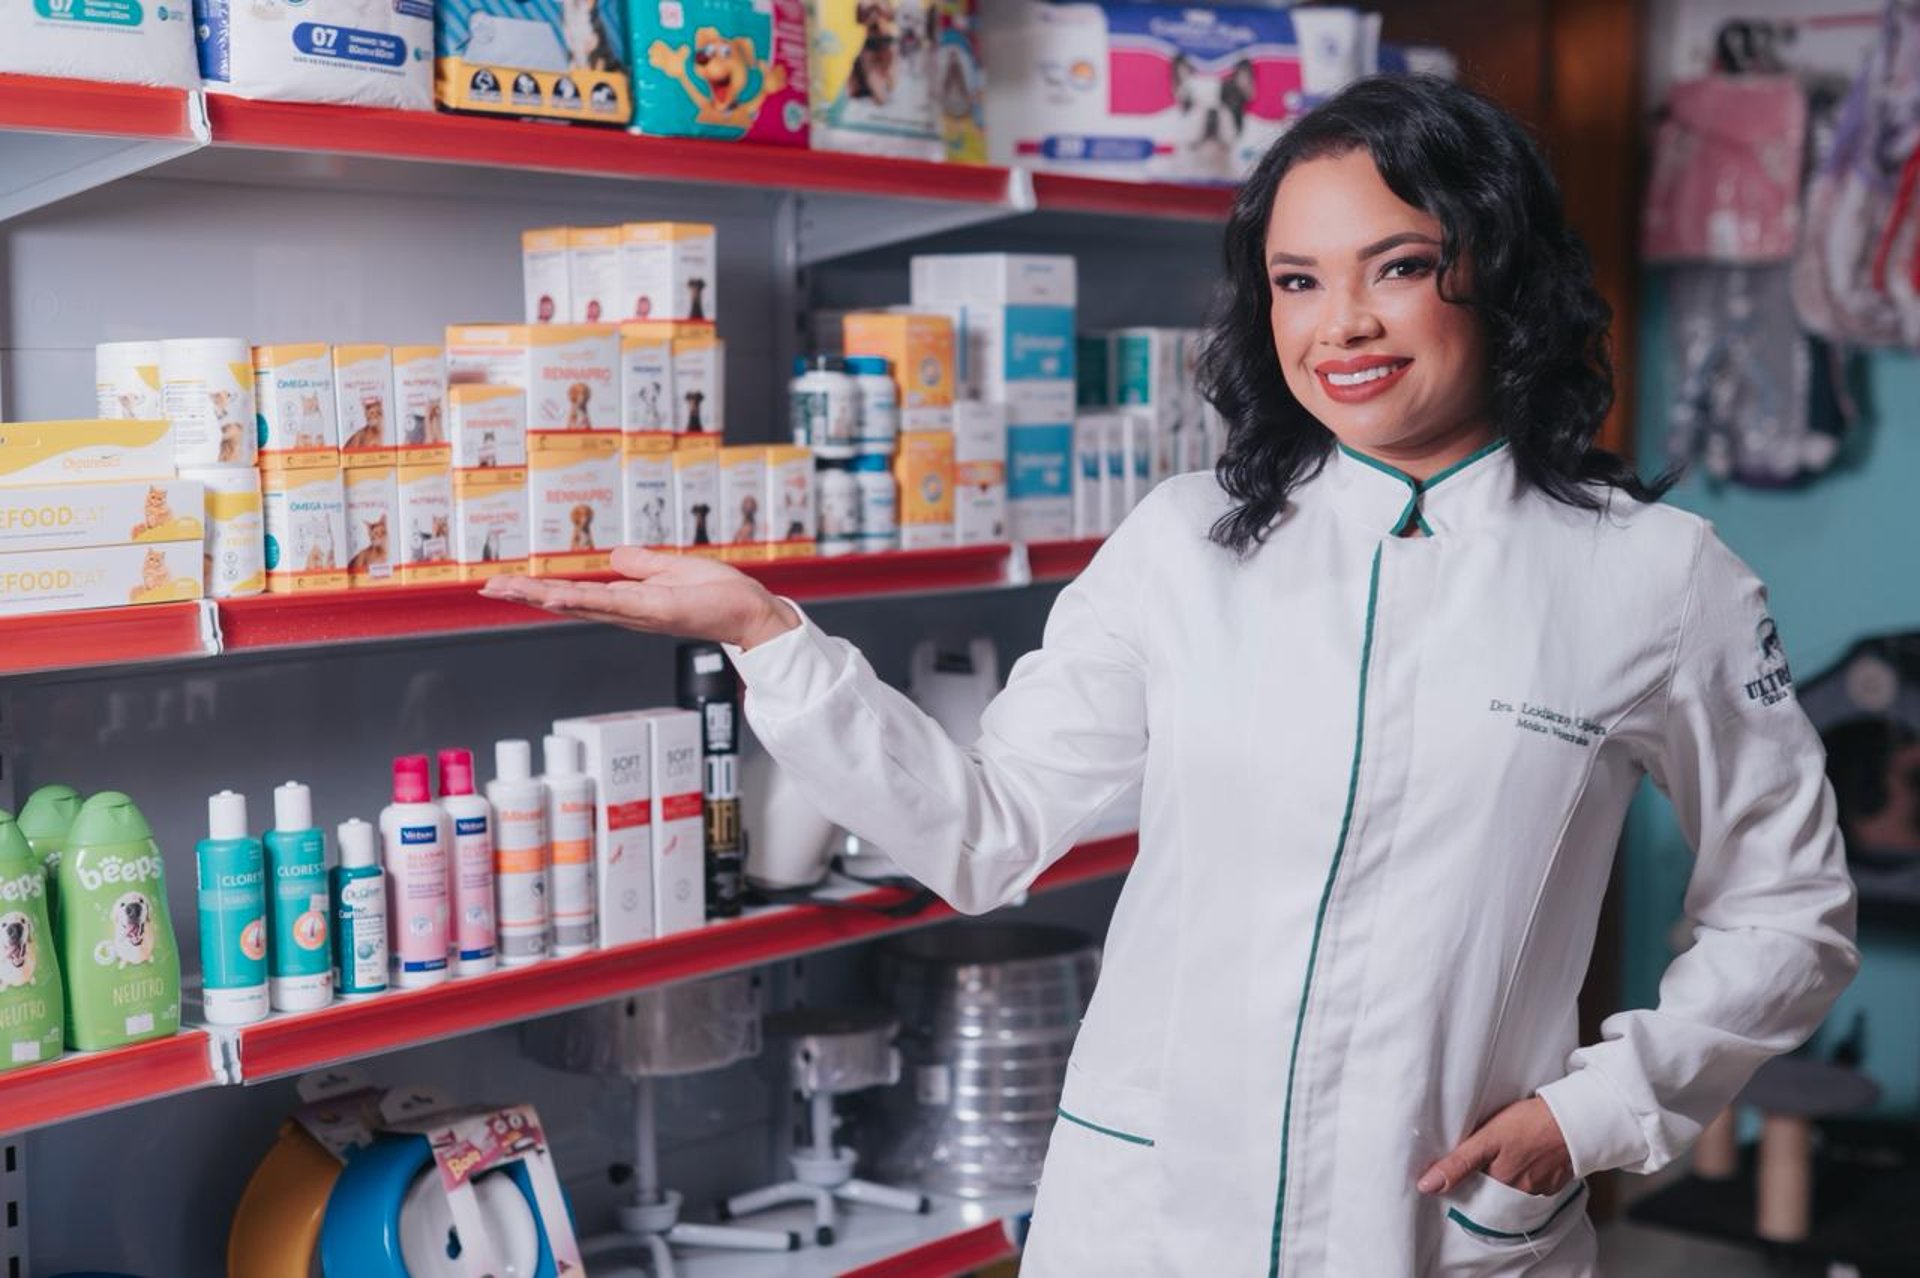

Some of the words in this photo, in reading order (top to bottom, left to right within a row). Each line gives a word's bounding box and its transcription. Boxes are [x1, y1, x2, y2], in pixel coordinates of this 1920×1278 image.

[311, 27, 338, 48] 07
[612, 754, 641, 772] SOFT
[667, 747, 695, 766] SOFT
[76, 850, 162, 891] beeps
[112, 978, 164, 1008] NEUTRO
